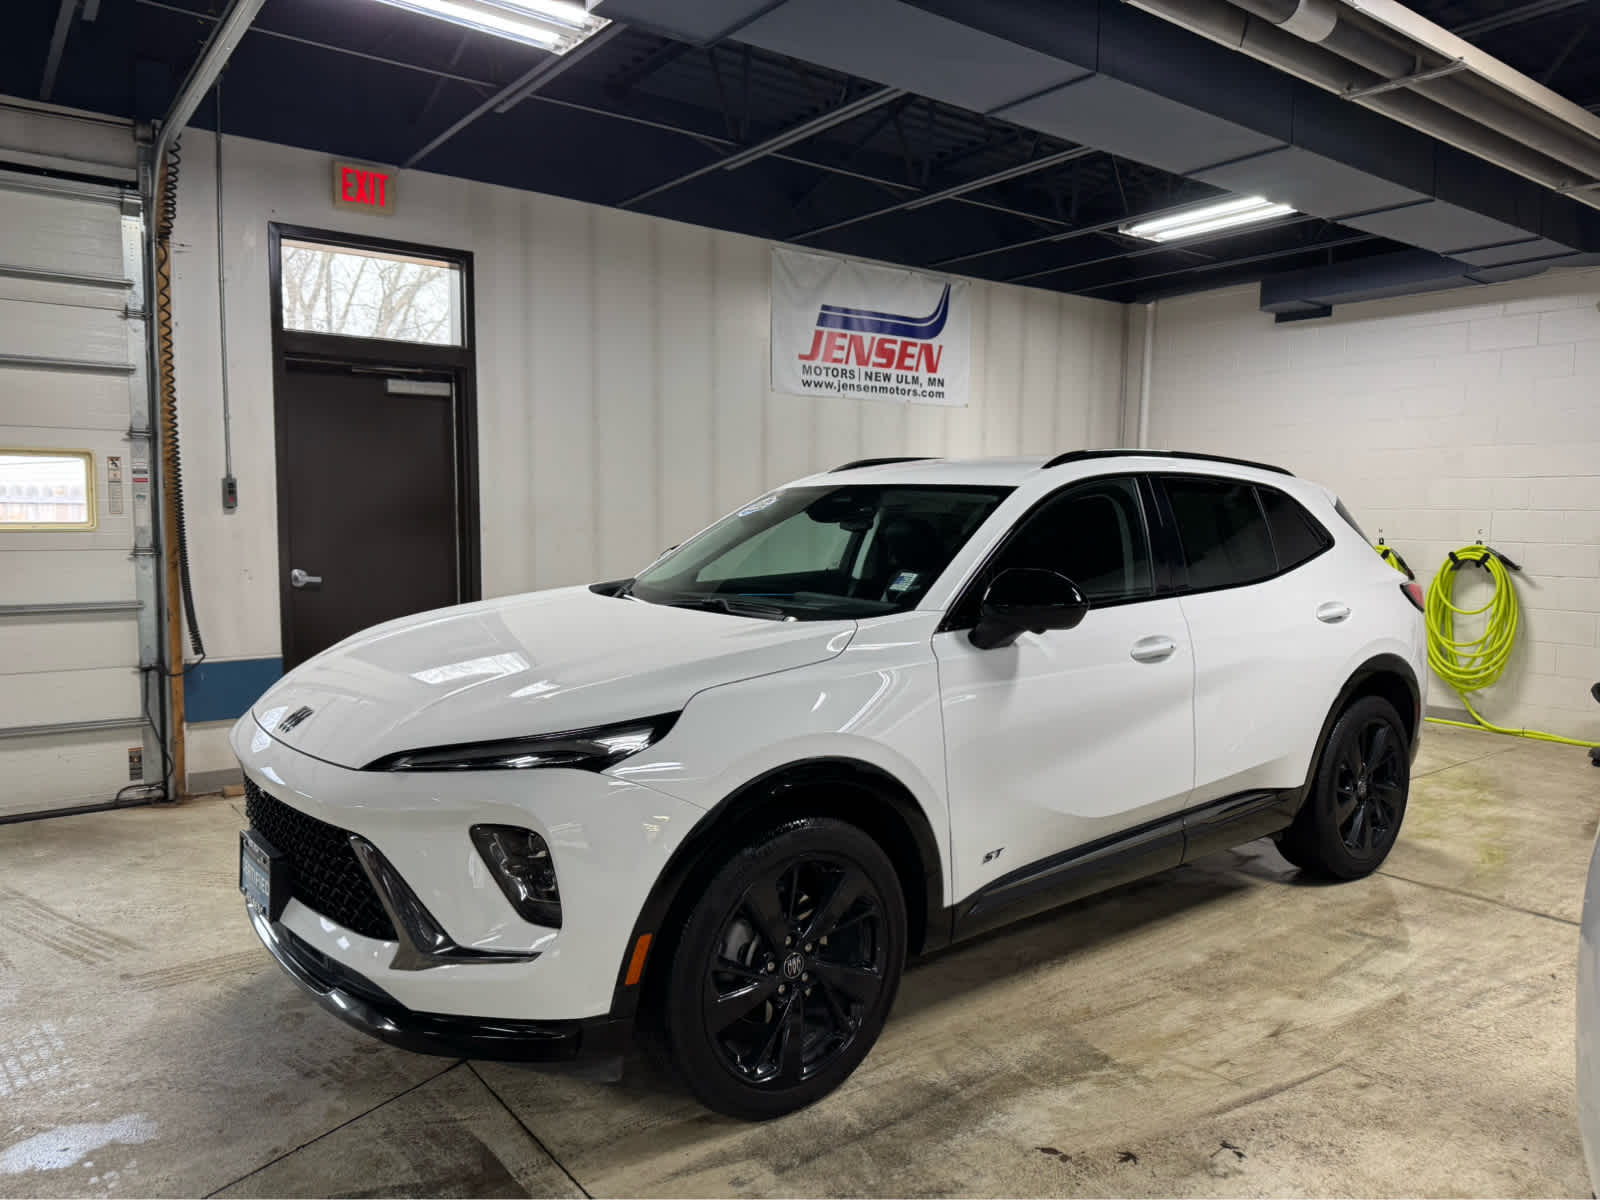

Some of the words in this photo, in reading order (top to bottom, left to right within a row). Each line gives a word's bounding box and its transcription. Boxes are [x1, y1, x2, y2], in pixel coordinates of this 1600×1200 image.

[342, 167, 389, 207] EXIT
[798, 329, 943, 374] JENSEN
[802, 364, 856, 380] MOTORS
[864, 371, 892, 383] NEW
[896, 373, 923, 388] ULM,
[927, 376, 945, 388] MN
[801, 378, 945, 399] www.jensenmotors.com
[982, 847, 1005, 864] ST
